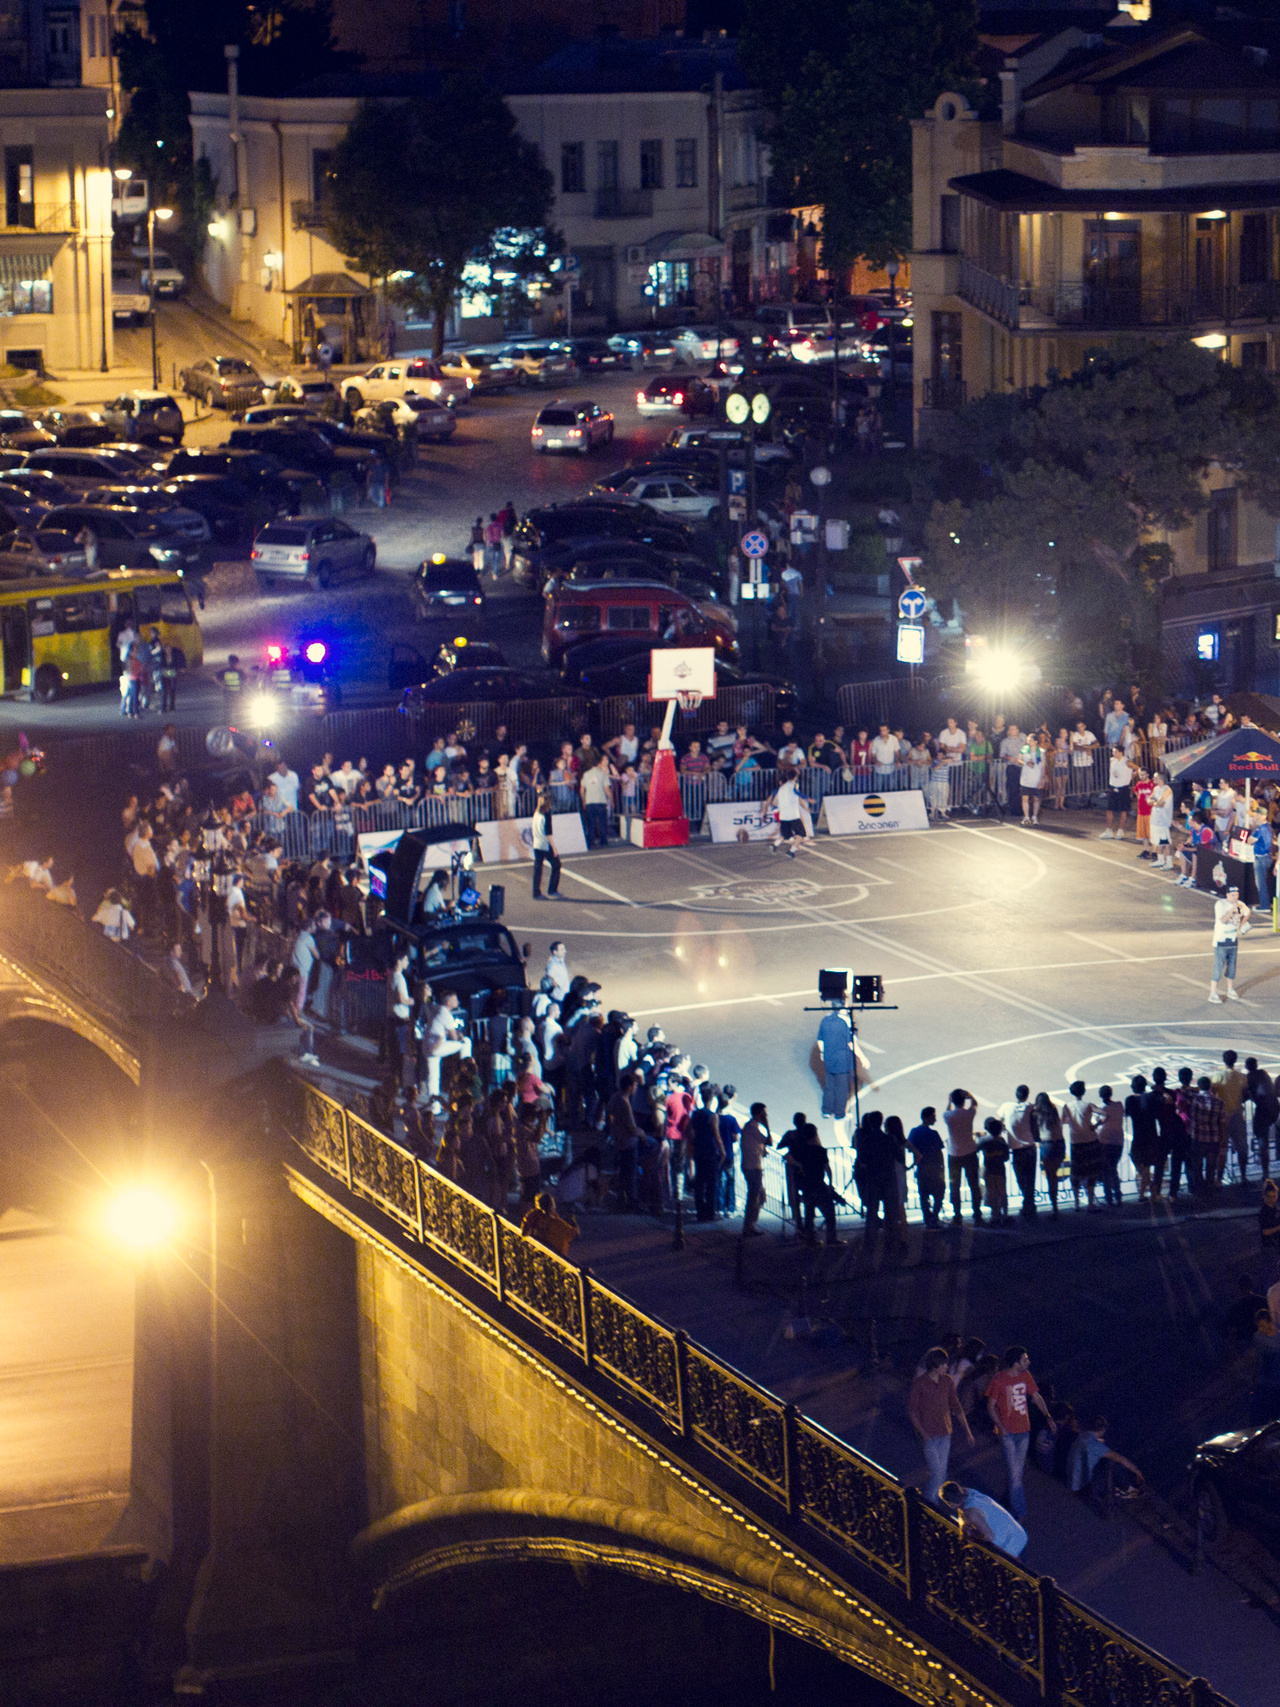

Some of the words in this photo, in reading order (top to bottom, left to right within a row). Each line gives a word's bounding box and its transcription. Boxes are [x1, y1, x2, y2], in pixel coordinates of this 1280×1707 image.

[858, 751, 867, 766] 7
[1228, 762, 1254, 771] Red
[1254, 762, 1279, 771] Bull
[1239, 829, 1249, 844] 4
